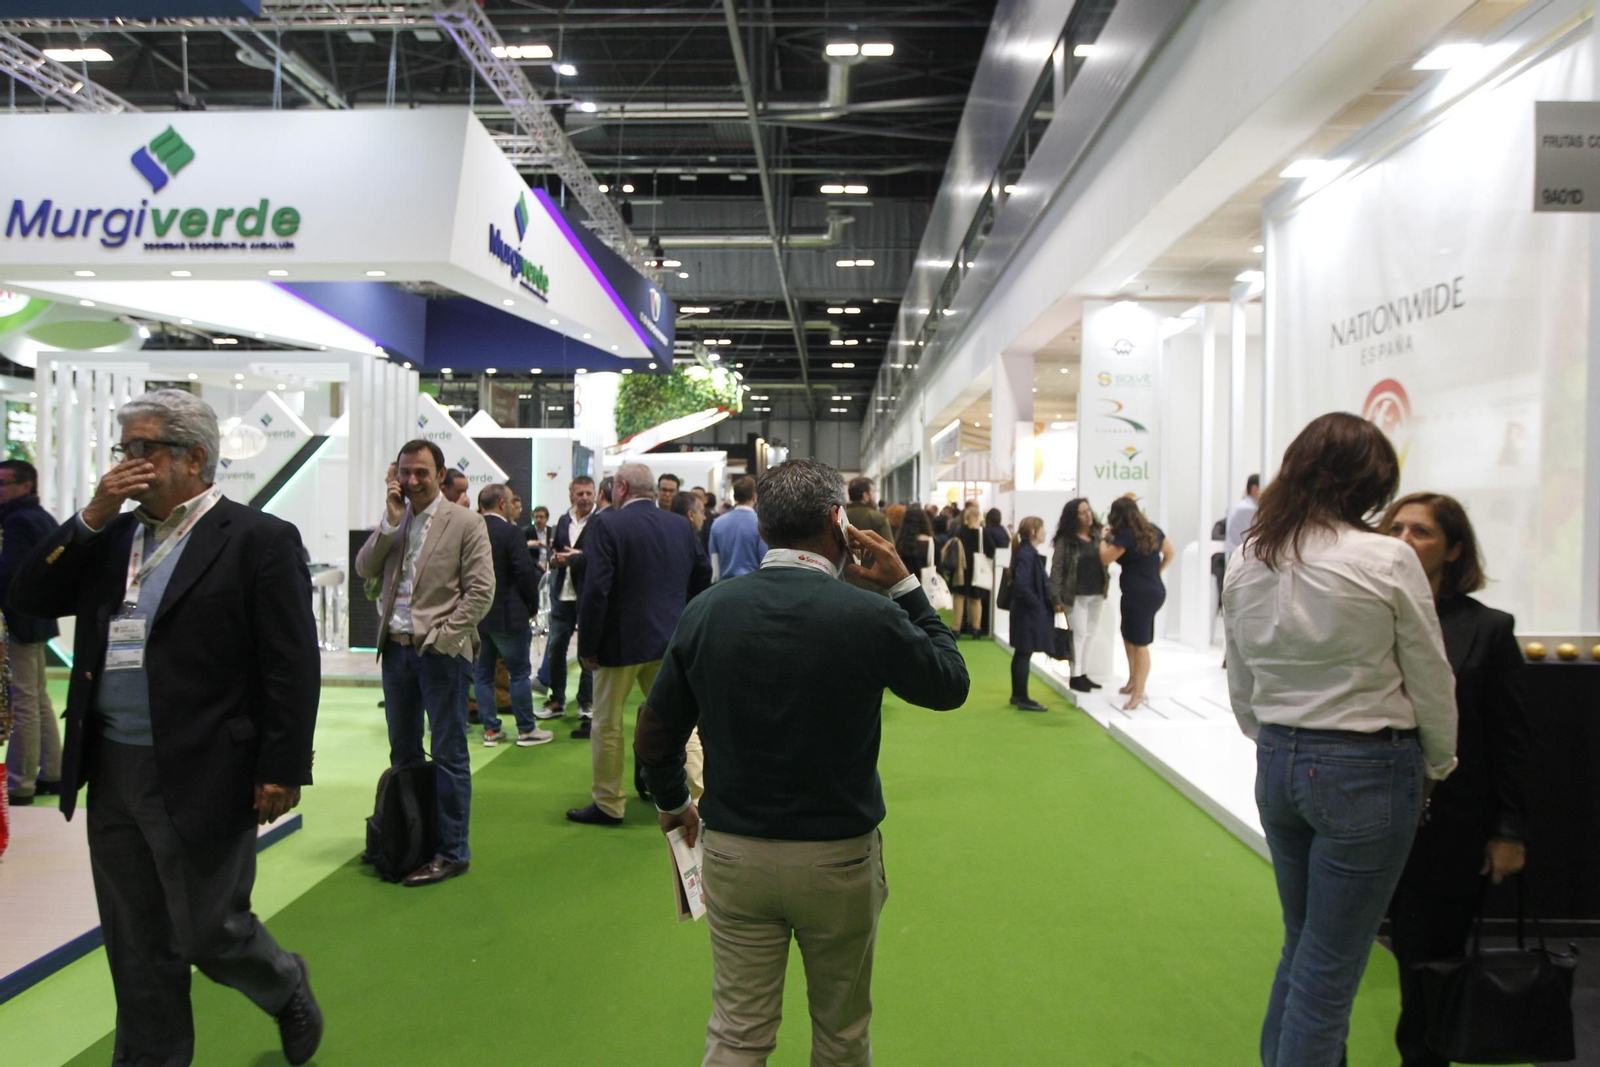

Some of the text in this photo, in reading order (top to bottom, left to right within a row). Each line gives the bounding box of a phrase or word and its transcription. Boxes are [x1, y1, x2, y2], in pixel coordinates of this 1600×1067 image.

[5, 198, 301, 248] Murgiverde
[1330, 275, 1466, 349] NATIONWIDE
[1094, 461, 1149, 481] vitaal
